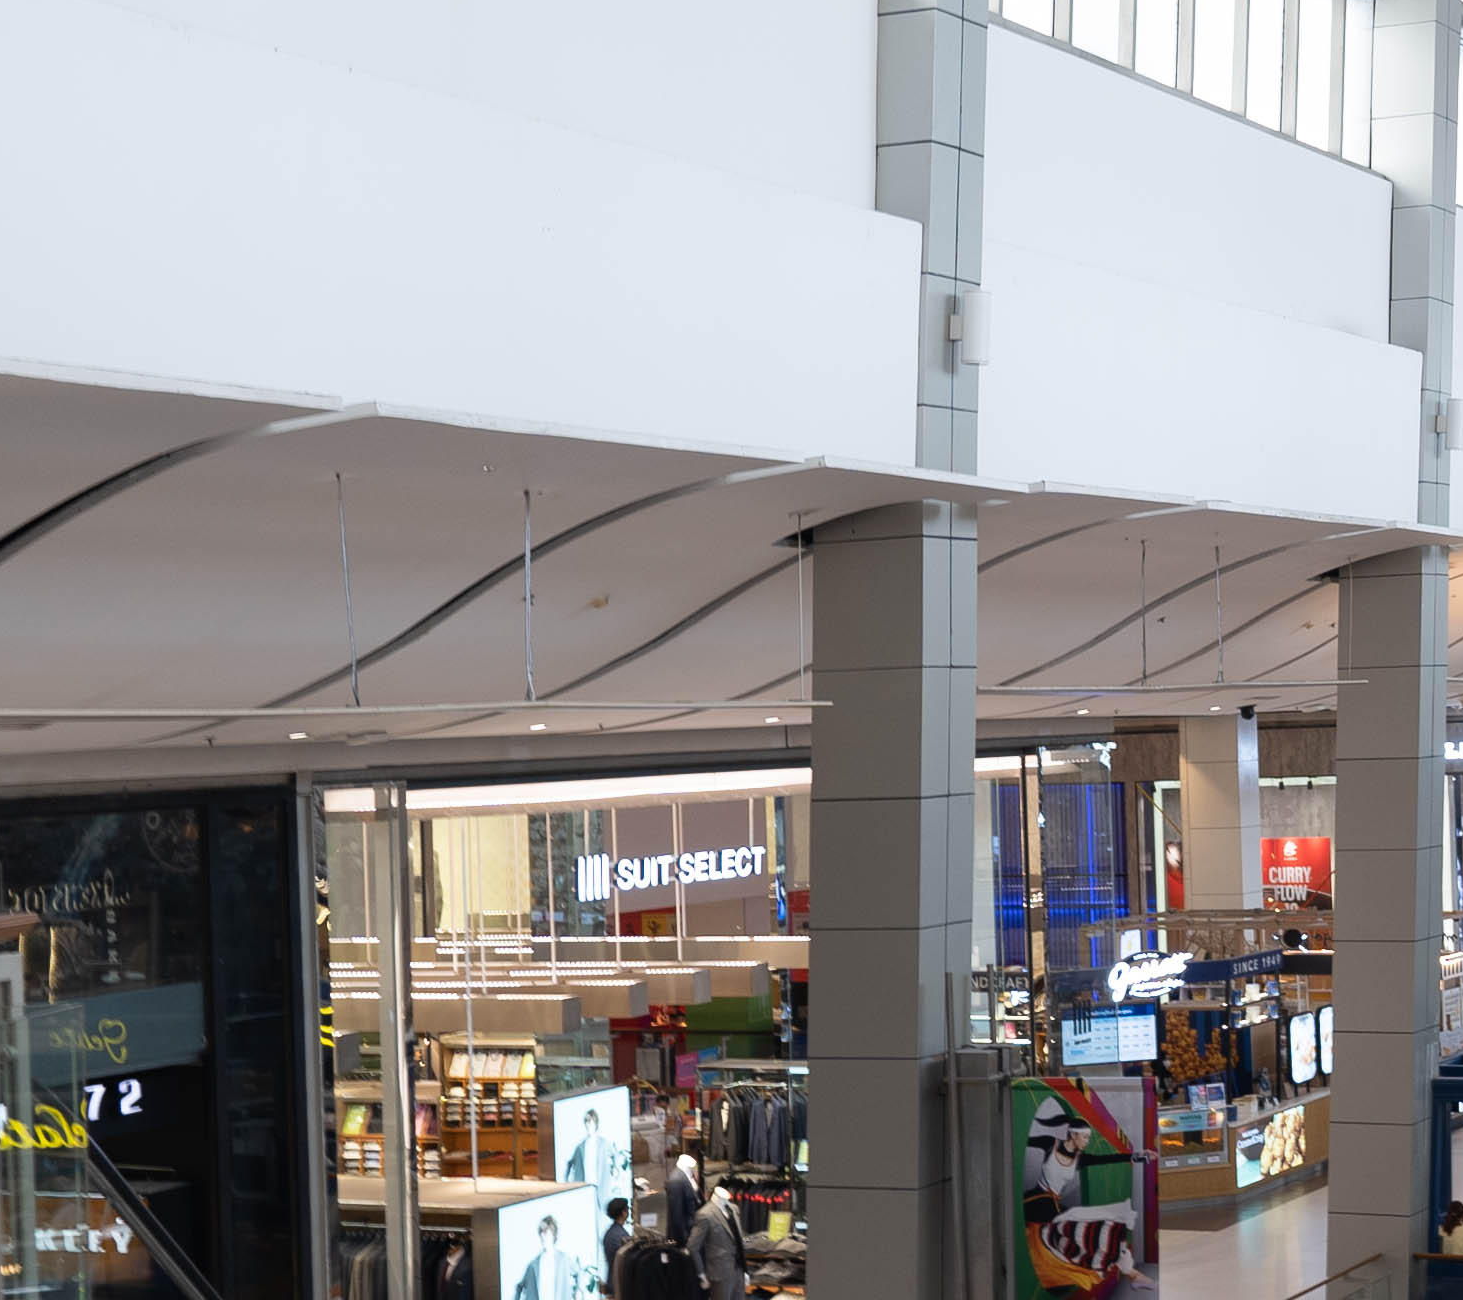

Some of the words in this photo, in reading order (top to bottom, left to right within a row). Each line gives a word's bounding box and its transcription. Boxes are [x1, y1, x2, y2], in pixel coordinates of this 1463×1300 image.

[616, 853, 674, 891] SUIT
[678, 845, 766, 885] SELECT
[1268, 865, 1312, 884] CURRY
[1274, 884, 1308, 902] FLOW
[1233, 959, 1260, 975] SINCE
